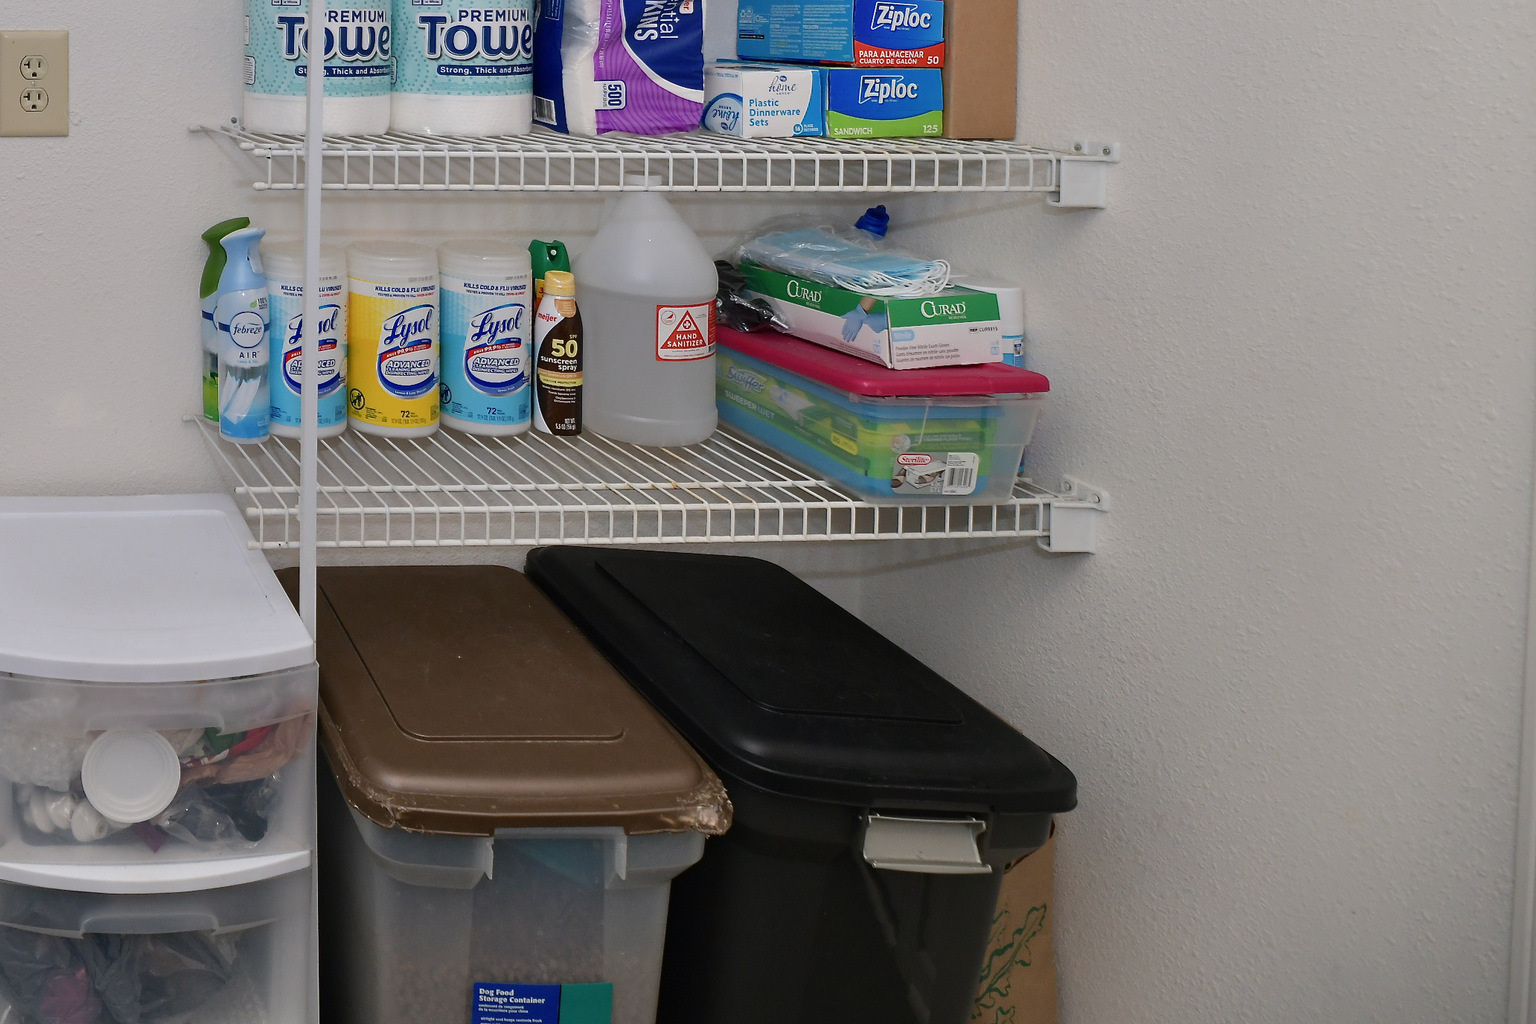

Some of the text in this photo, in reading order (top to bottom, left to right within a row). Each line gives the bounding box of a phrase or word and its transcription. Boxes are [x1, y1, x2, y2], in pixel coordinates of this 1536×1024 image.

[325, 10, 384, 23] REMIUM
[458, 9, 527, 22] PREMIUM
[876, 5, 931, 31] Ziploc
[859, 50, 924, 58] PARA ALMACENAR
[926, 56, 939, 65] 50
[332, 67, 354, 75] Thick
[356, 67, 367, 75] and
[440, 66, 472, 75] Strong,
[475, 66, 497, 74] Thick
[499, 66, 512, 74] and
[608, 84, 622, 106] 500
[864, 78, 918, 104] Ziploc
[749, 98, 779, 107] Plastic
[749, 108, 801, 117] Dinnerware
[749, 118, 769, 127] Sets
[834, 127, 873, 135] SANDWICH
[923, 125, 938, 134] 125
[463, 282, 480, 290] KILLS
[787, 280, 822, 303] CURAD
[921, 301, 966, 318] CURAD
[538, 312, 557, 322] meijer
[232, 322, 263, 336] febreze
[383, 309, 433, 346] Lysol
[470, 307, 523, 344] Lysol
[667, 339, 703, 347] SANITIZER
[551, 338, 578, 358] 50
[239, 351, 257, 359] AIR
[386, 359, 431, 368] ADVANCED
[473, 357, 520, 366] ADVANCED
[540, 355, 578, 365] sunscreen
[558, 364, 577, 372] spray
[726, 365, 766, 393] Swiffer
[725, 389, 775, 420] SWEEPER WET
[400, 410, 410, 418] 72
[486, 407, 496, 415] 72
[479, 988, 494, 996] Dog
[479, 995, 545, 1004] Storage Container
